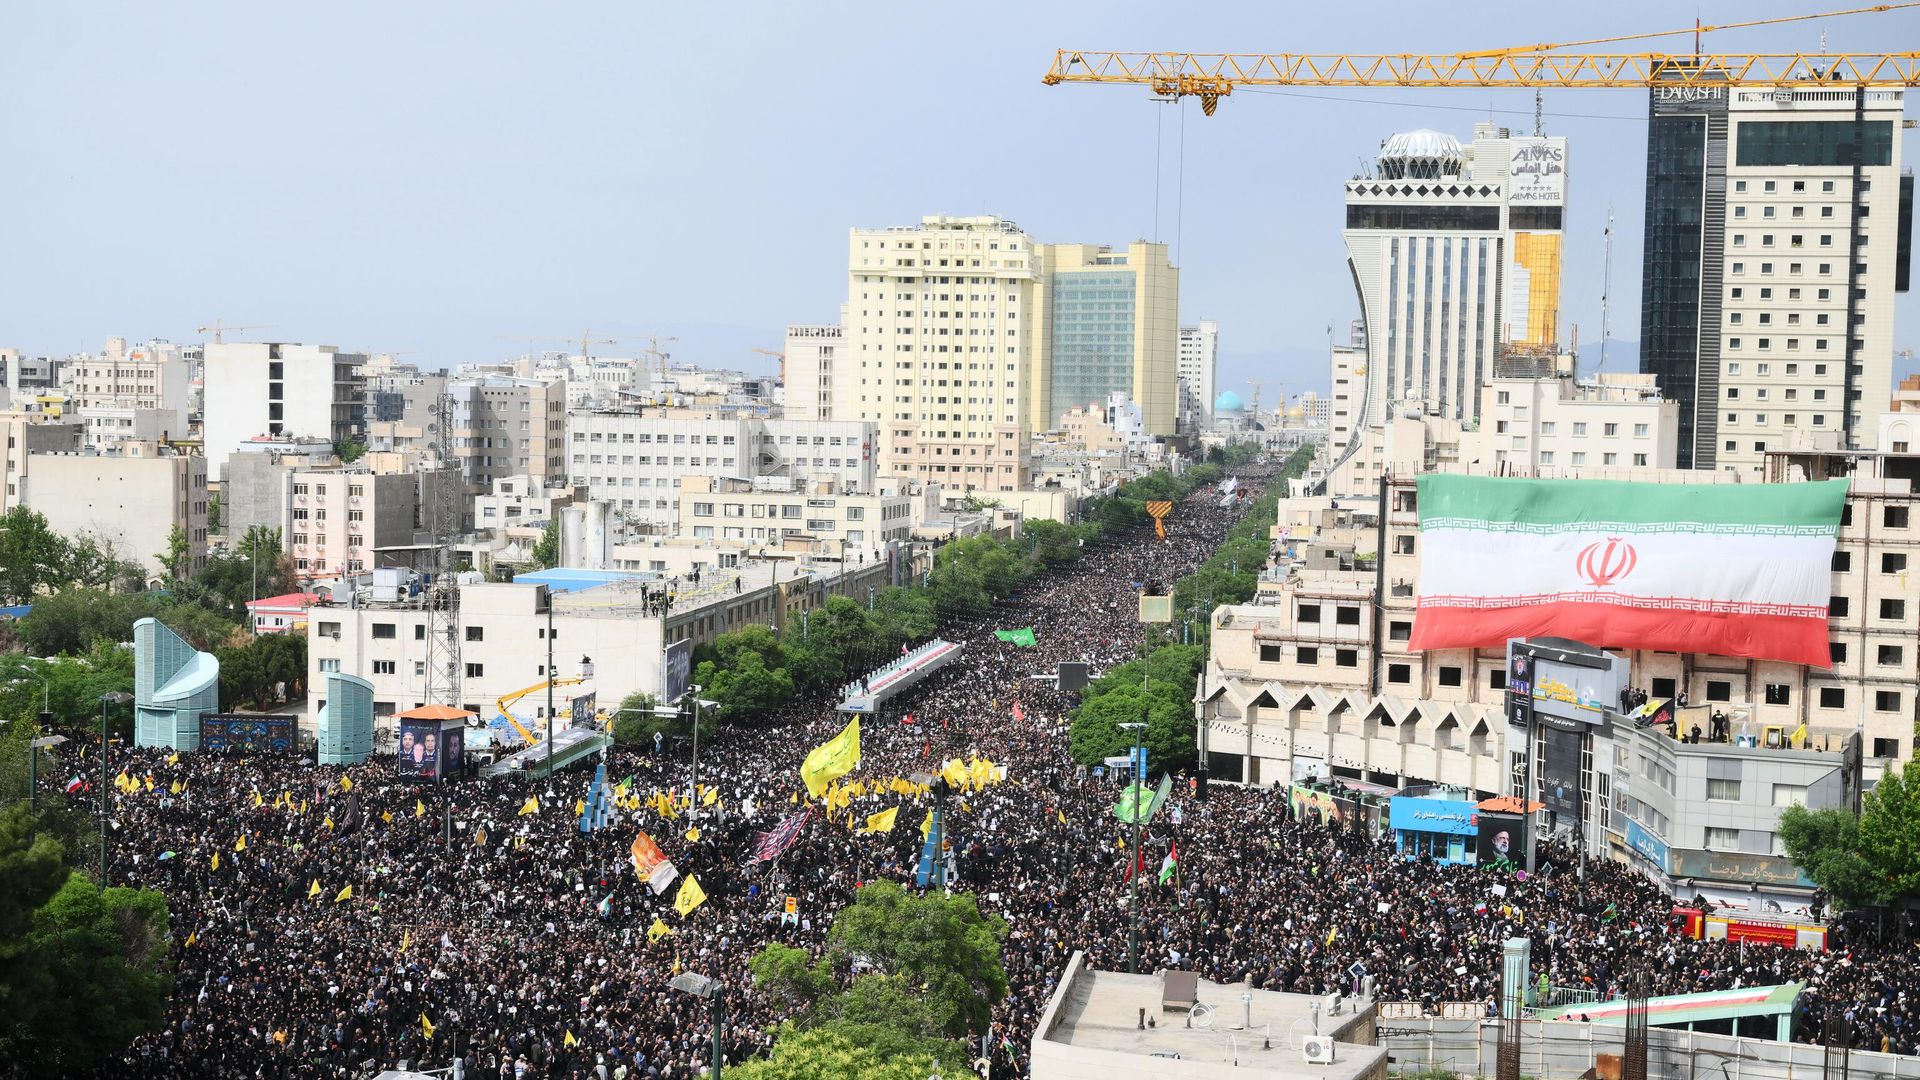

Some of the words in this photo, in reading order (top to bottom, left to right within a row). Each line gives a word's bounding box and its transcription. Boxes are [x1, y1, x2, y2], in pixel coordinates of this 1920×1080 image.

[1511, 147, 1563, 162] ALMAS
[1533, 174, 1540, 185] 2
[1510, 192, 1537, 200] ALMAS
[1538, 192, 1560, 200] HOTEL
